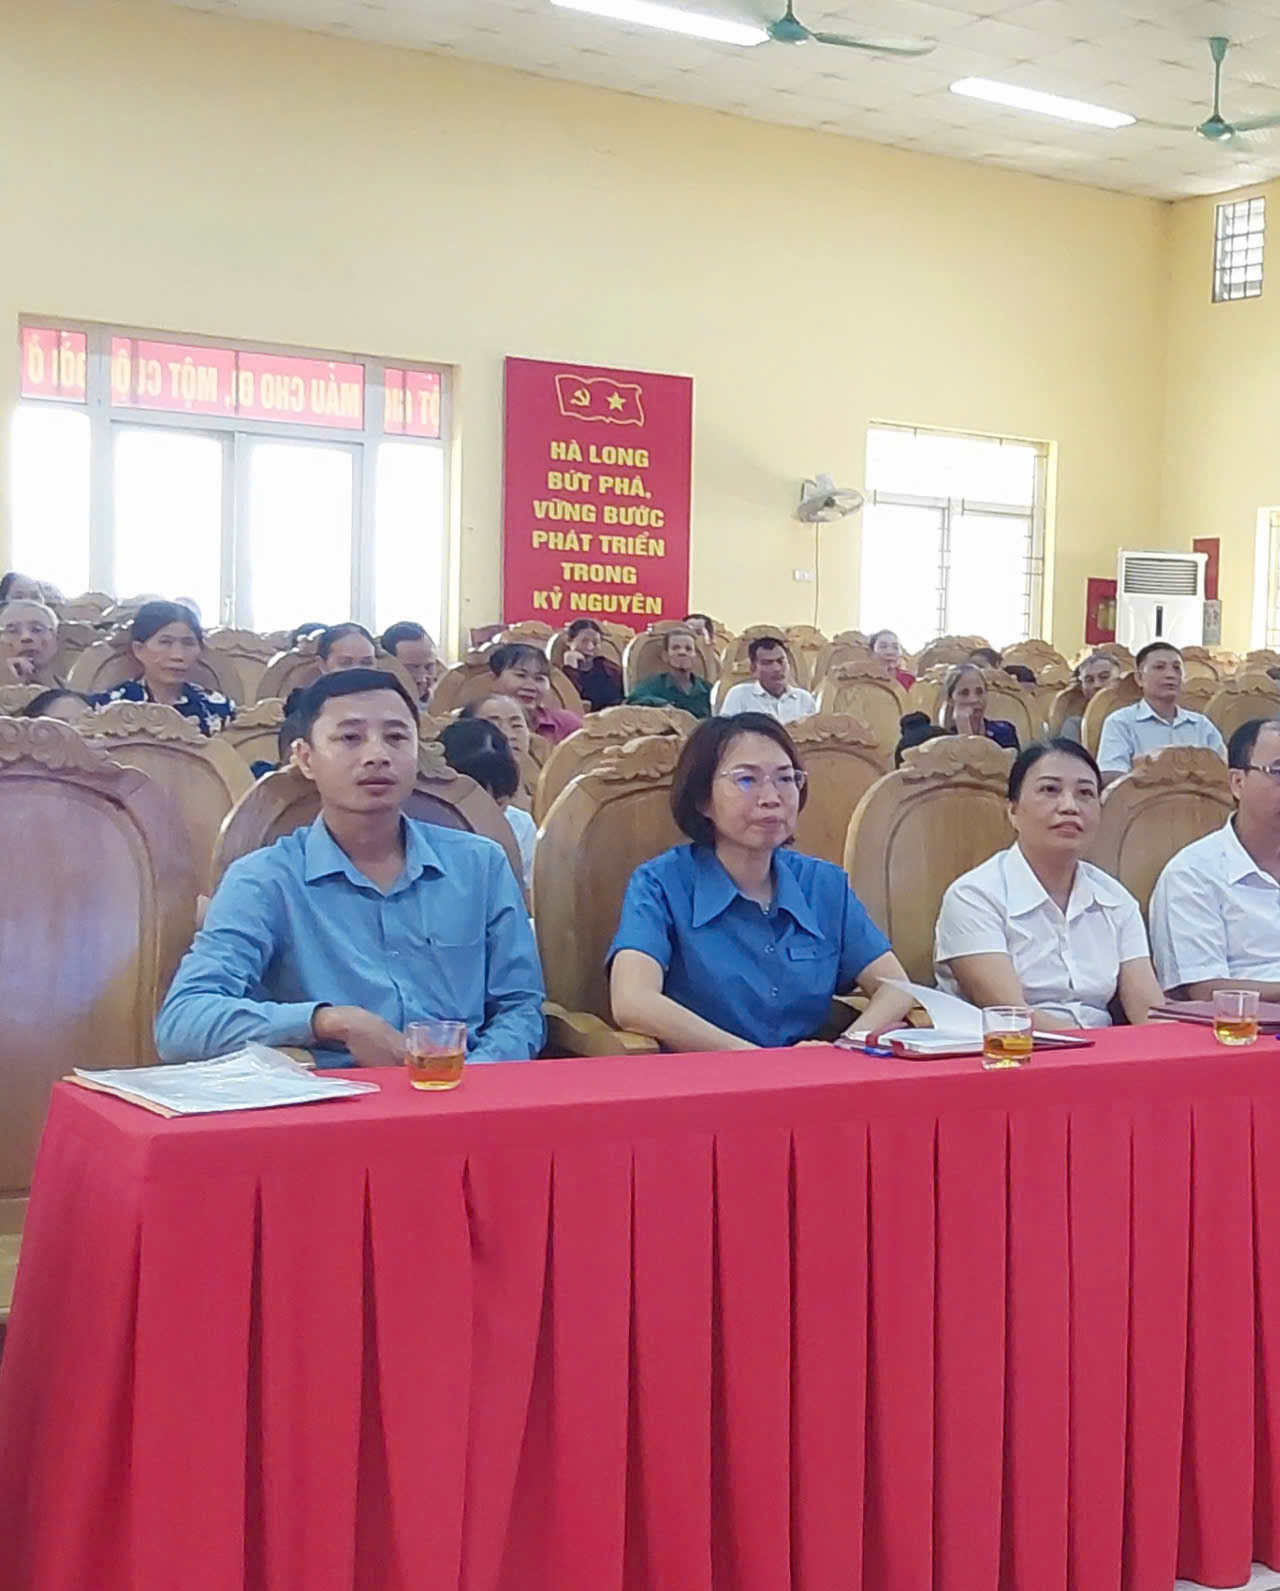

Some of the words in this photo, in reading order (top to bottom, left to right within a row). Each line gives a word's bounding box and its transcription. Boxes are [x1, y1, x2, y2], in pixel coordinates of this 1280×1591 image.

[550, 440, 582, 462] HÀ
[590, 445, 649, 468] LONG
[548, 470, 592, 492] BỨT
[533, 498, 596, 523] VỮNG
[604, 505, 665, 527] BƯỚC
[532, 529, 593, 552] PHÁT
[599, 531, 666, 557] TRIỂN
[561, 562, 637, 584] TRONG
[533, 586, 563, 610] KỶ
[570, 593, 662, 615] NGUYÊN
